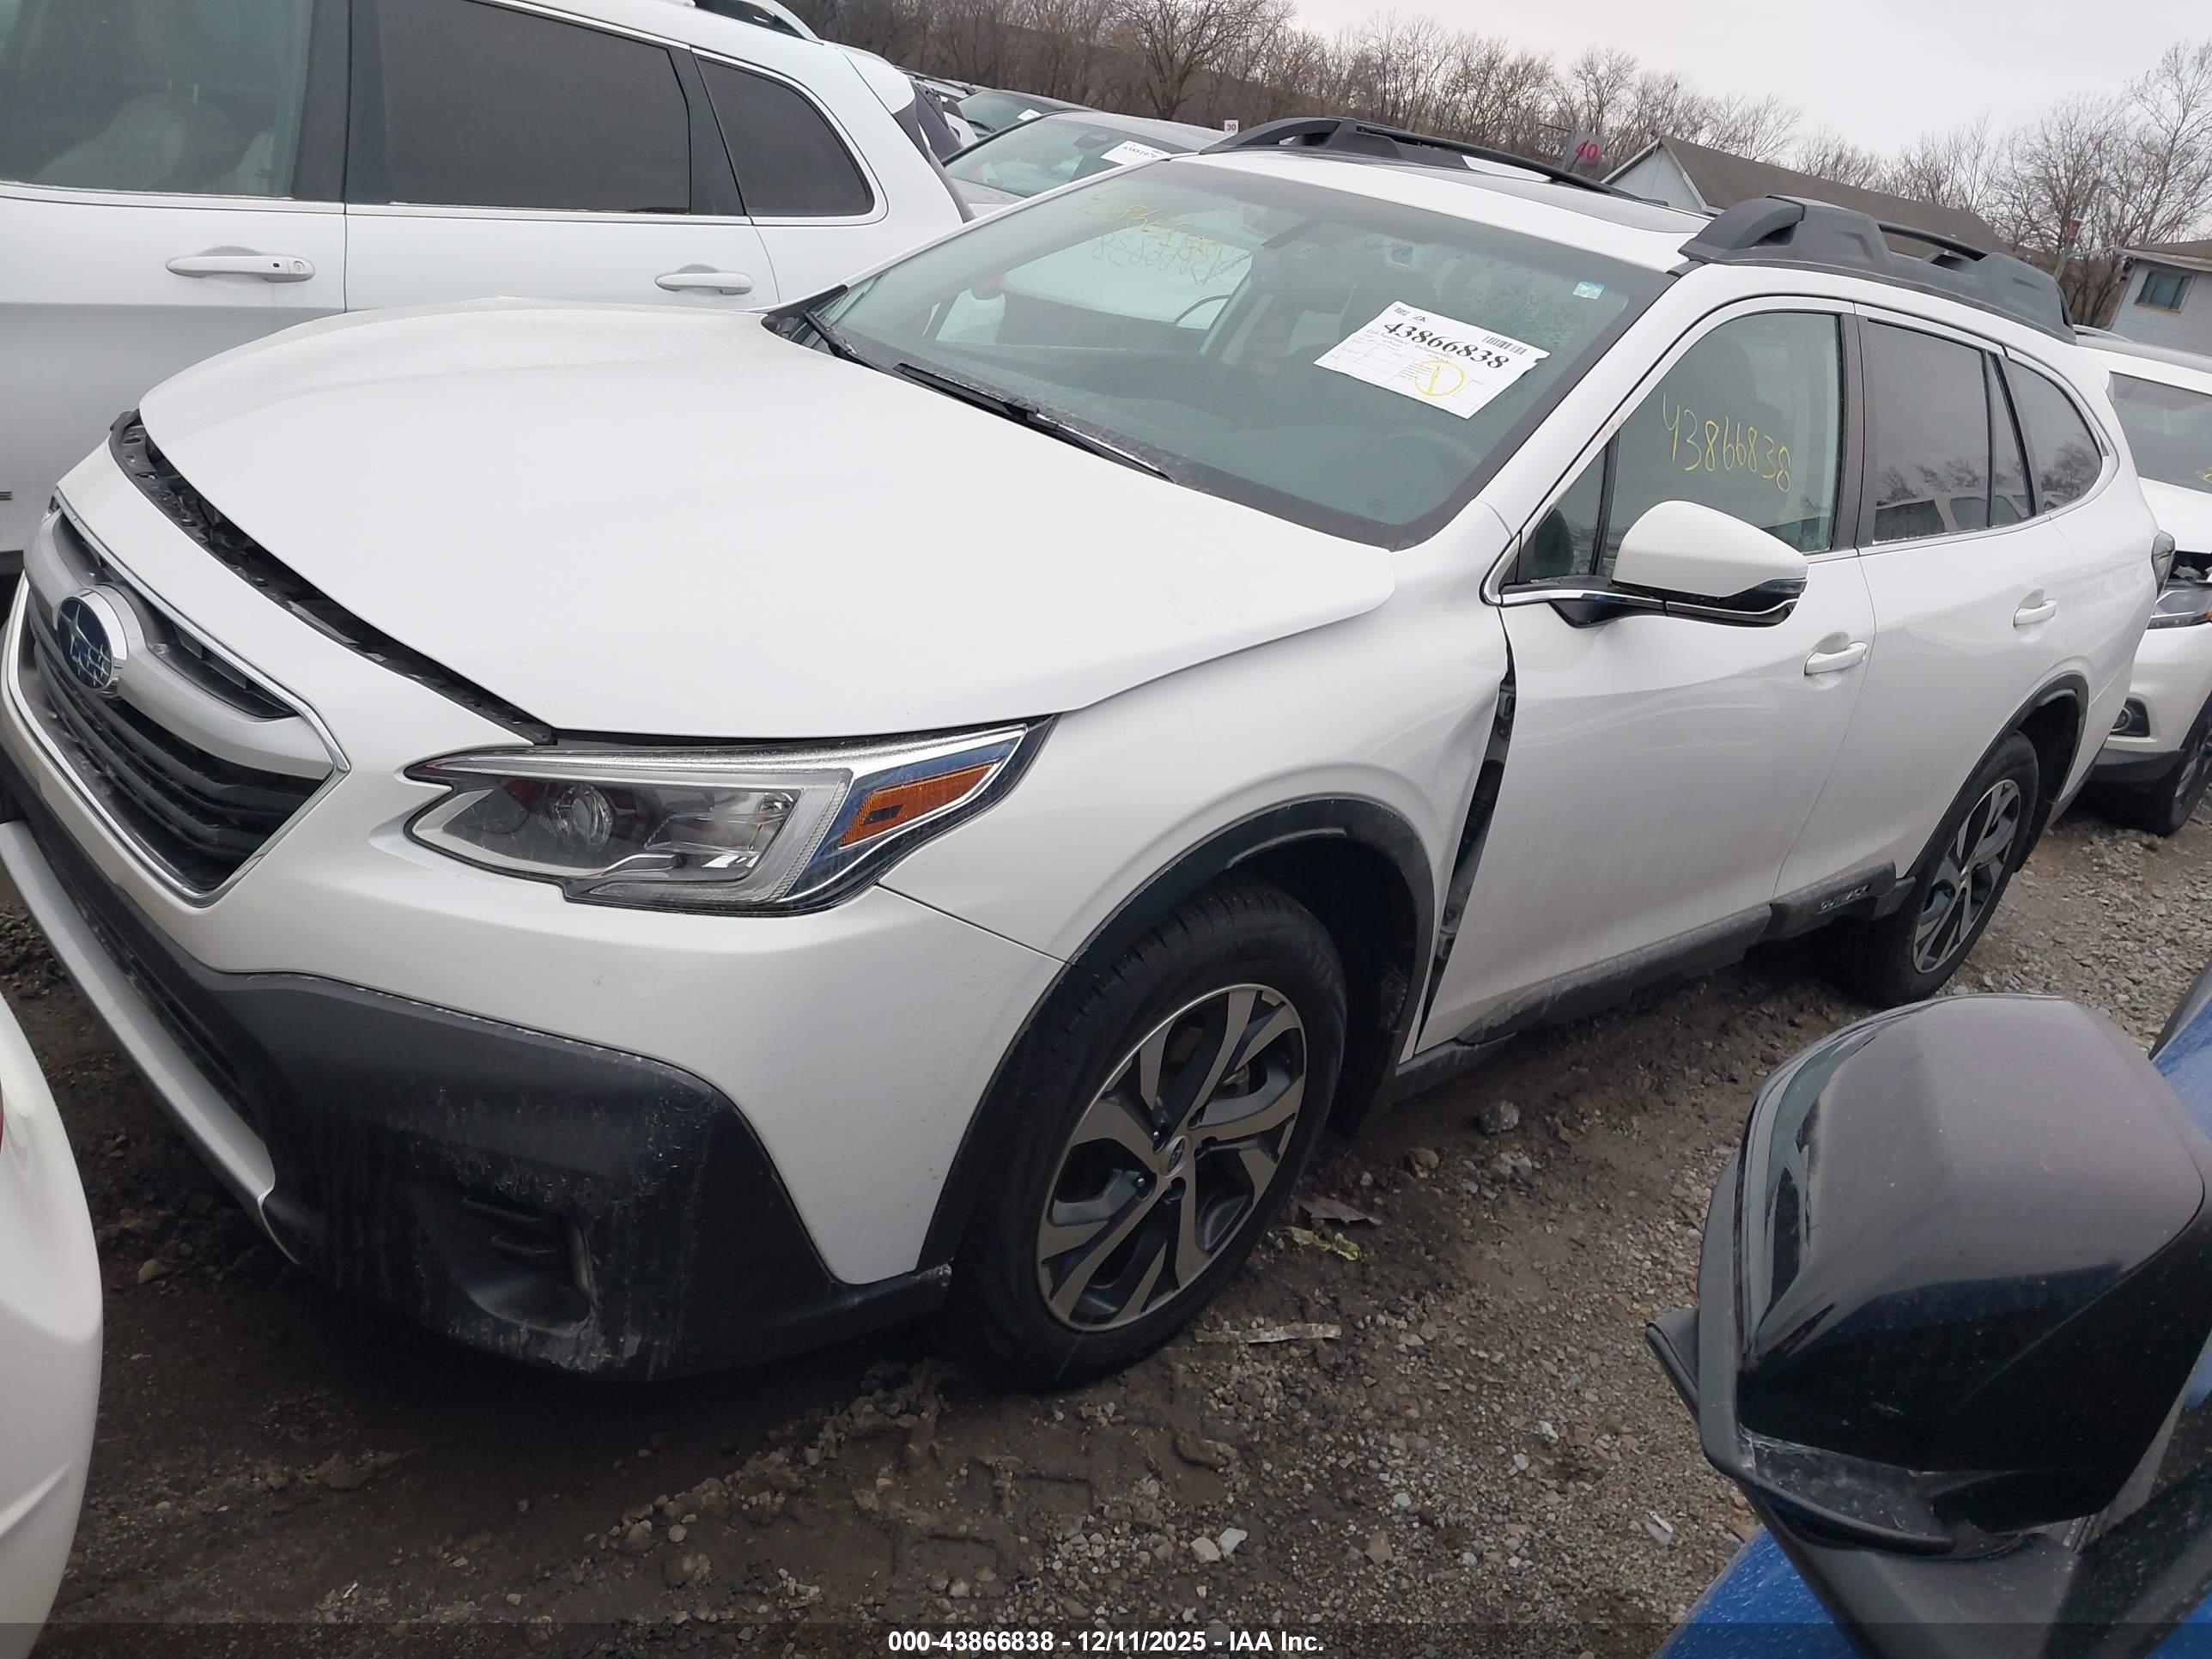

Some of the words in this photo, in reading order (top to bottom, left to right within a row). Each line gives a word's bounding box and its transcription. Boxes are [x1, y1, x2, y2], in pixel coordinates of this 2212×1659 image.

[1225, 123, 1237, 131] 30
[1575, 139, 1598, 160] 40
[1383, 322, 1510, 369] 43866838
[1662, 392, 1791, 493] 43866838
